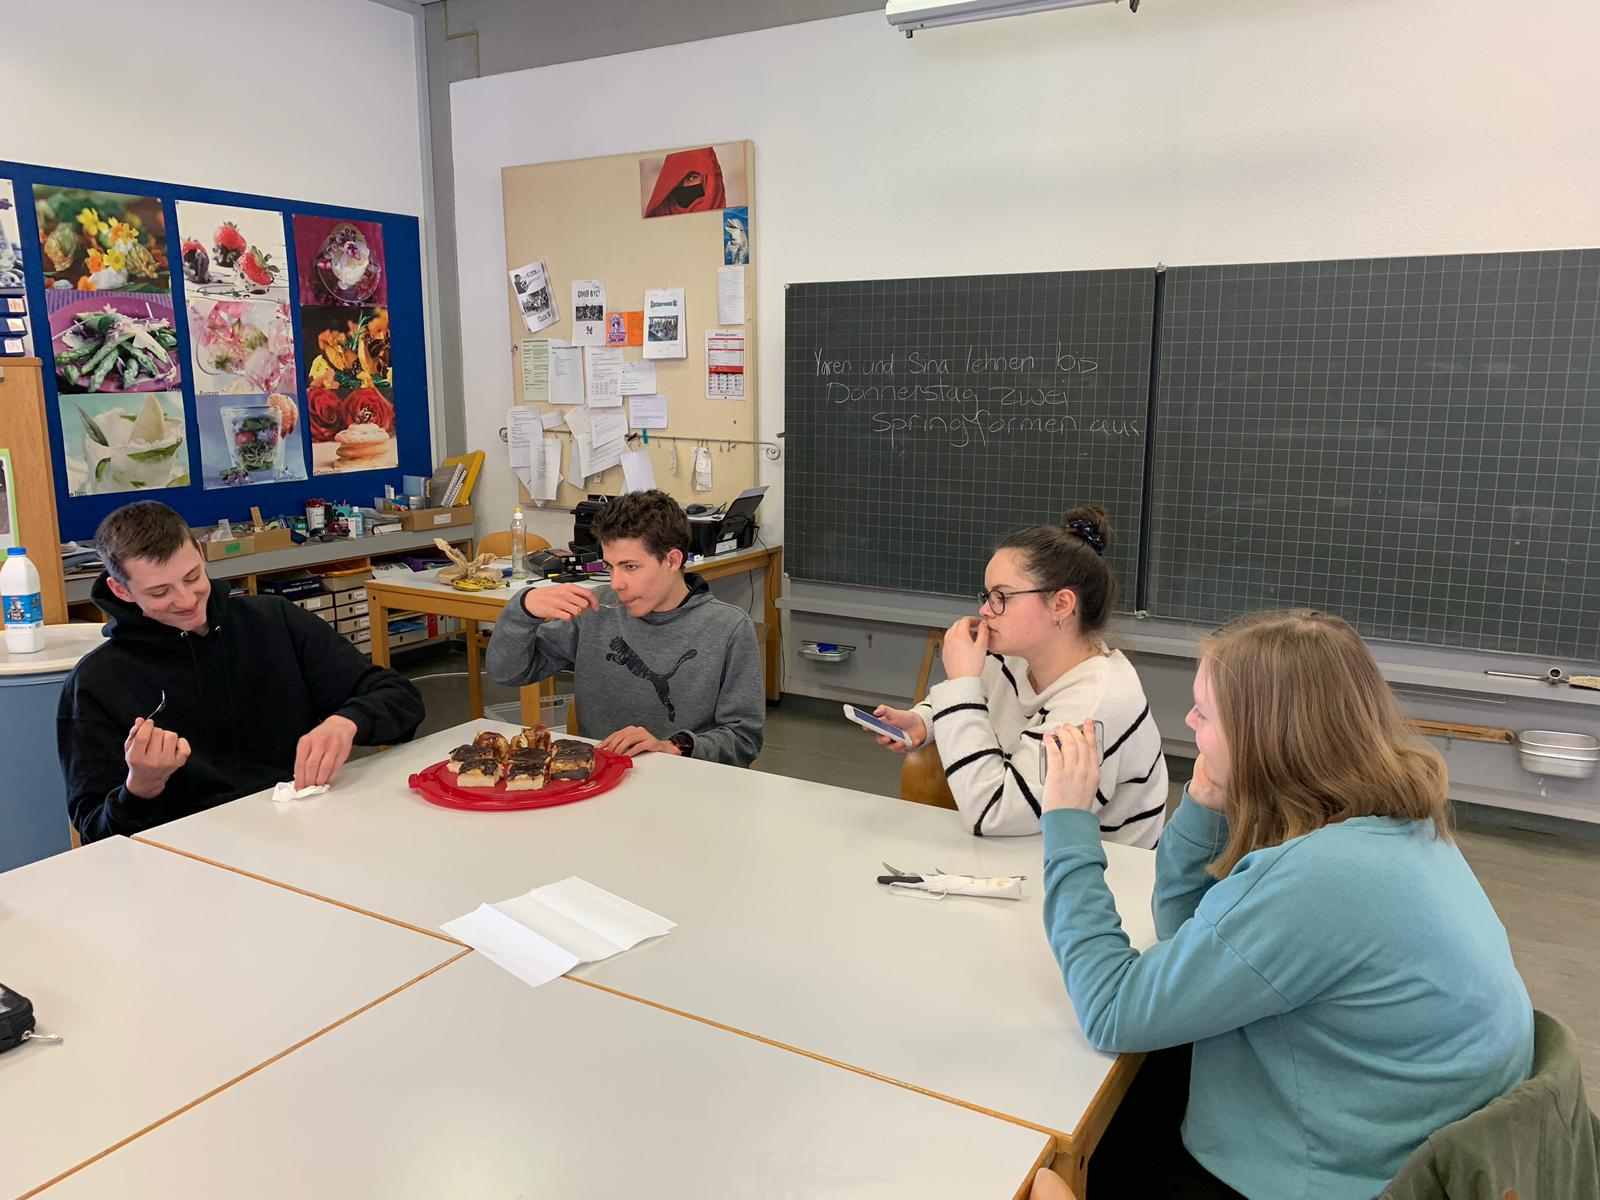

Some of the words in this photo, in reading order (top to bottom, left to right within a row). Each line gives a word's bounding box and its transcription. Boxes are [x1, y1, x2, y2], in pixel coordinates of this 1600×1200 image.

[862, 352, 894, 376] und
[908, 351, 949, 375] Sina
[966, 344, 1034, 374] lehnen
[826, 375, 980, 412] Donnerstag
[871, 408, 1078, 449] Springformen
[1089, 418, 1141, 438] aus
